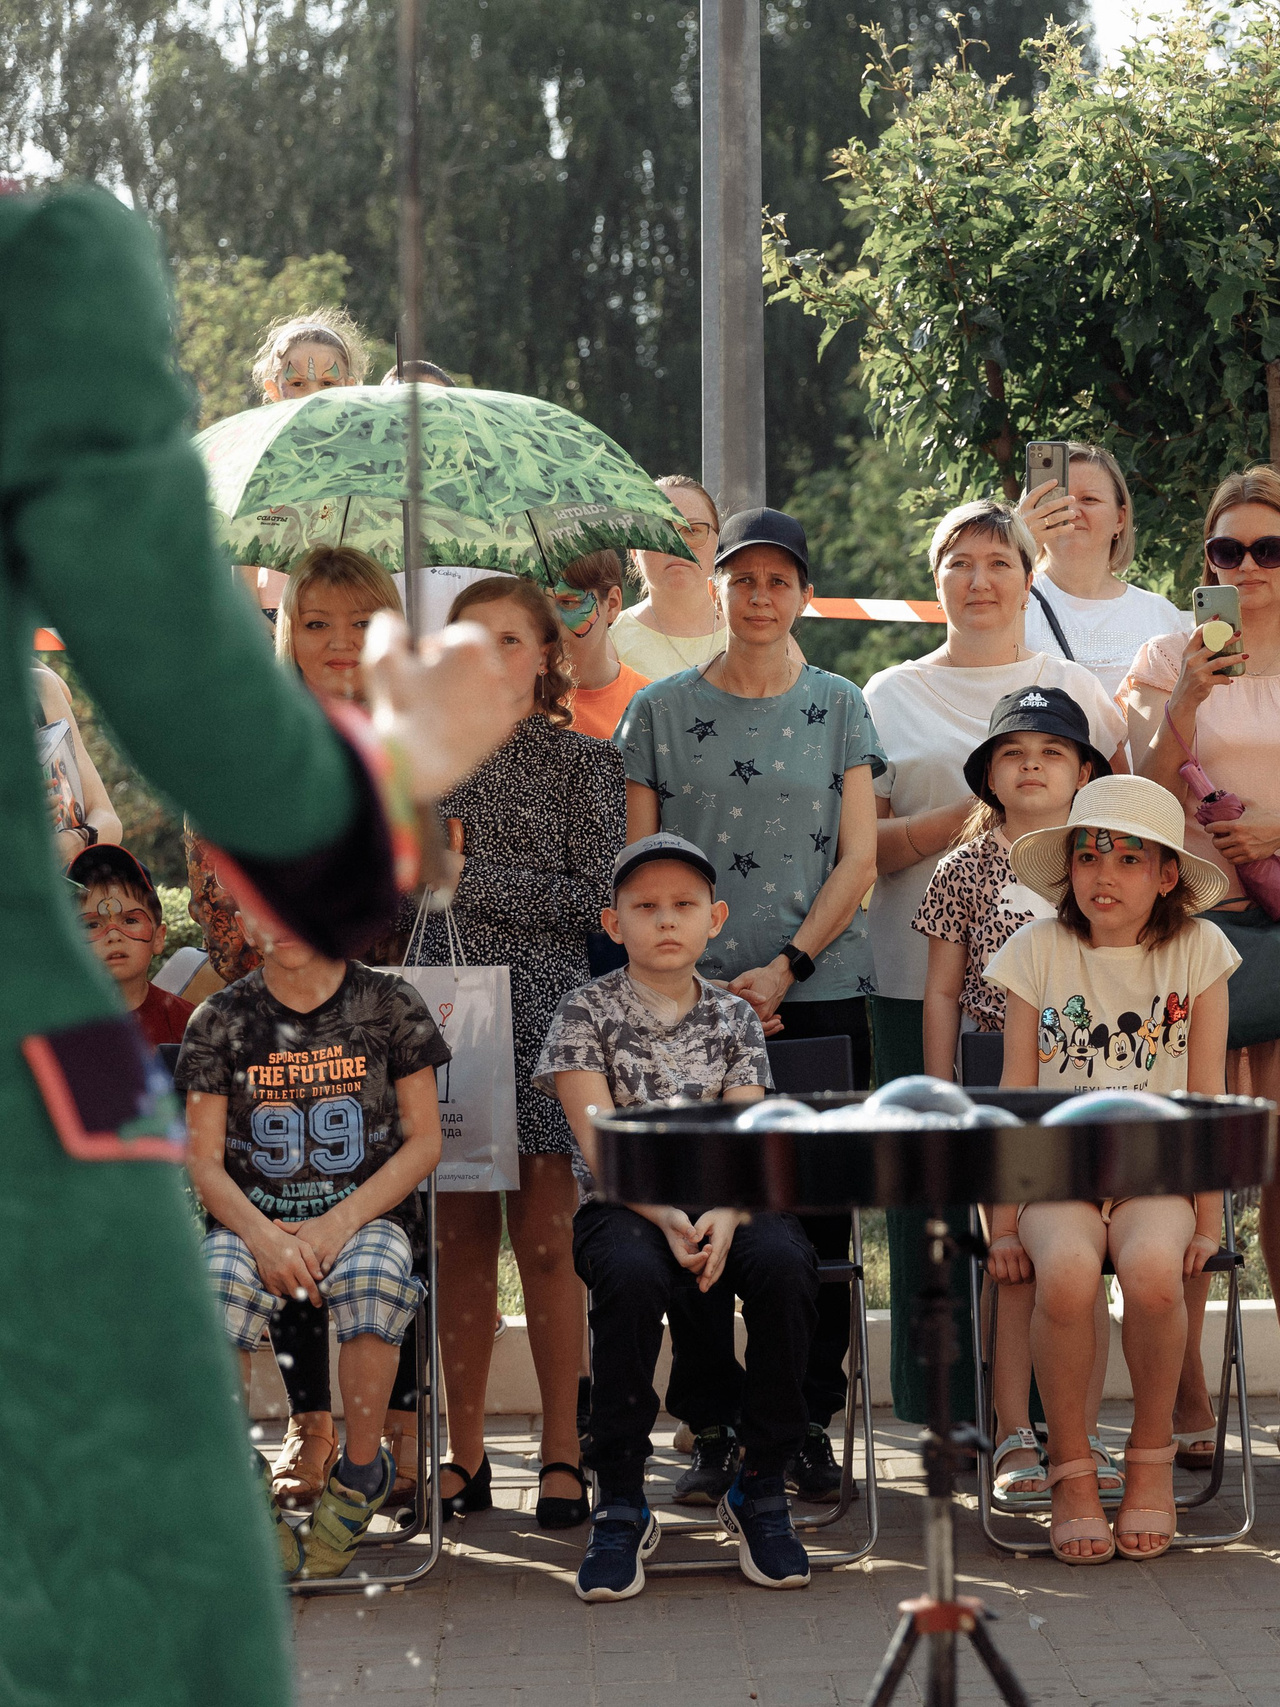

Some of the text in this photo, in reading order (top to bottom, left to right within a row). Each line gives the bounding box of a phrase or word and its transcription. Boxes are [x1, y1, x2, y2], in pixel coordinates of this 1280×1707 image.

[268, 1044, 343, 1065] SPORTS TEAM
[246, 1056, 367, 1086] THE FUTURE
[252, 1081, 362, 1100] ATHLETIC DIVISION
[251, 1096, 365, 1178] 99
[281, 1180, 334, 1198] ALWAYS
